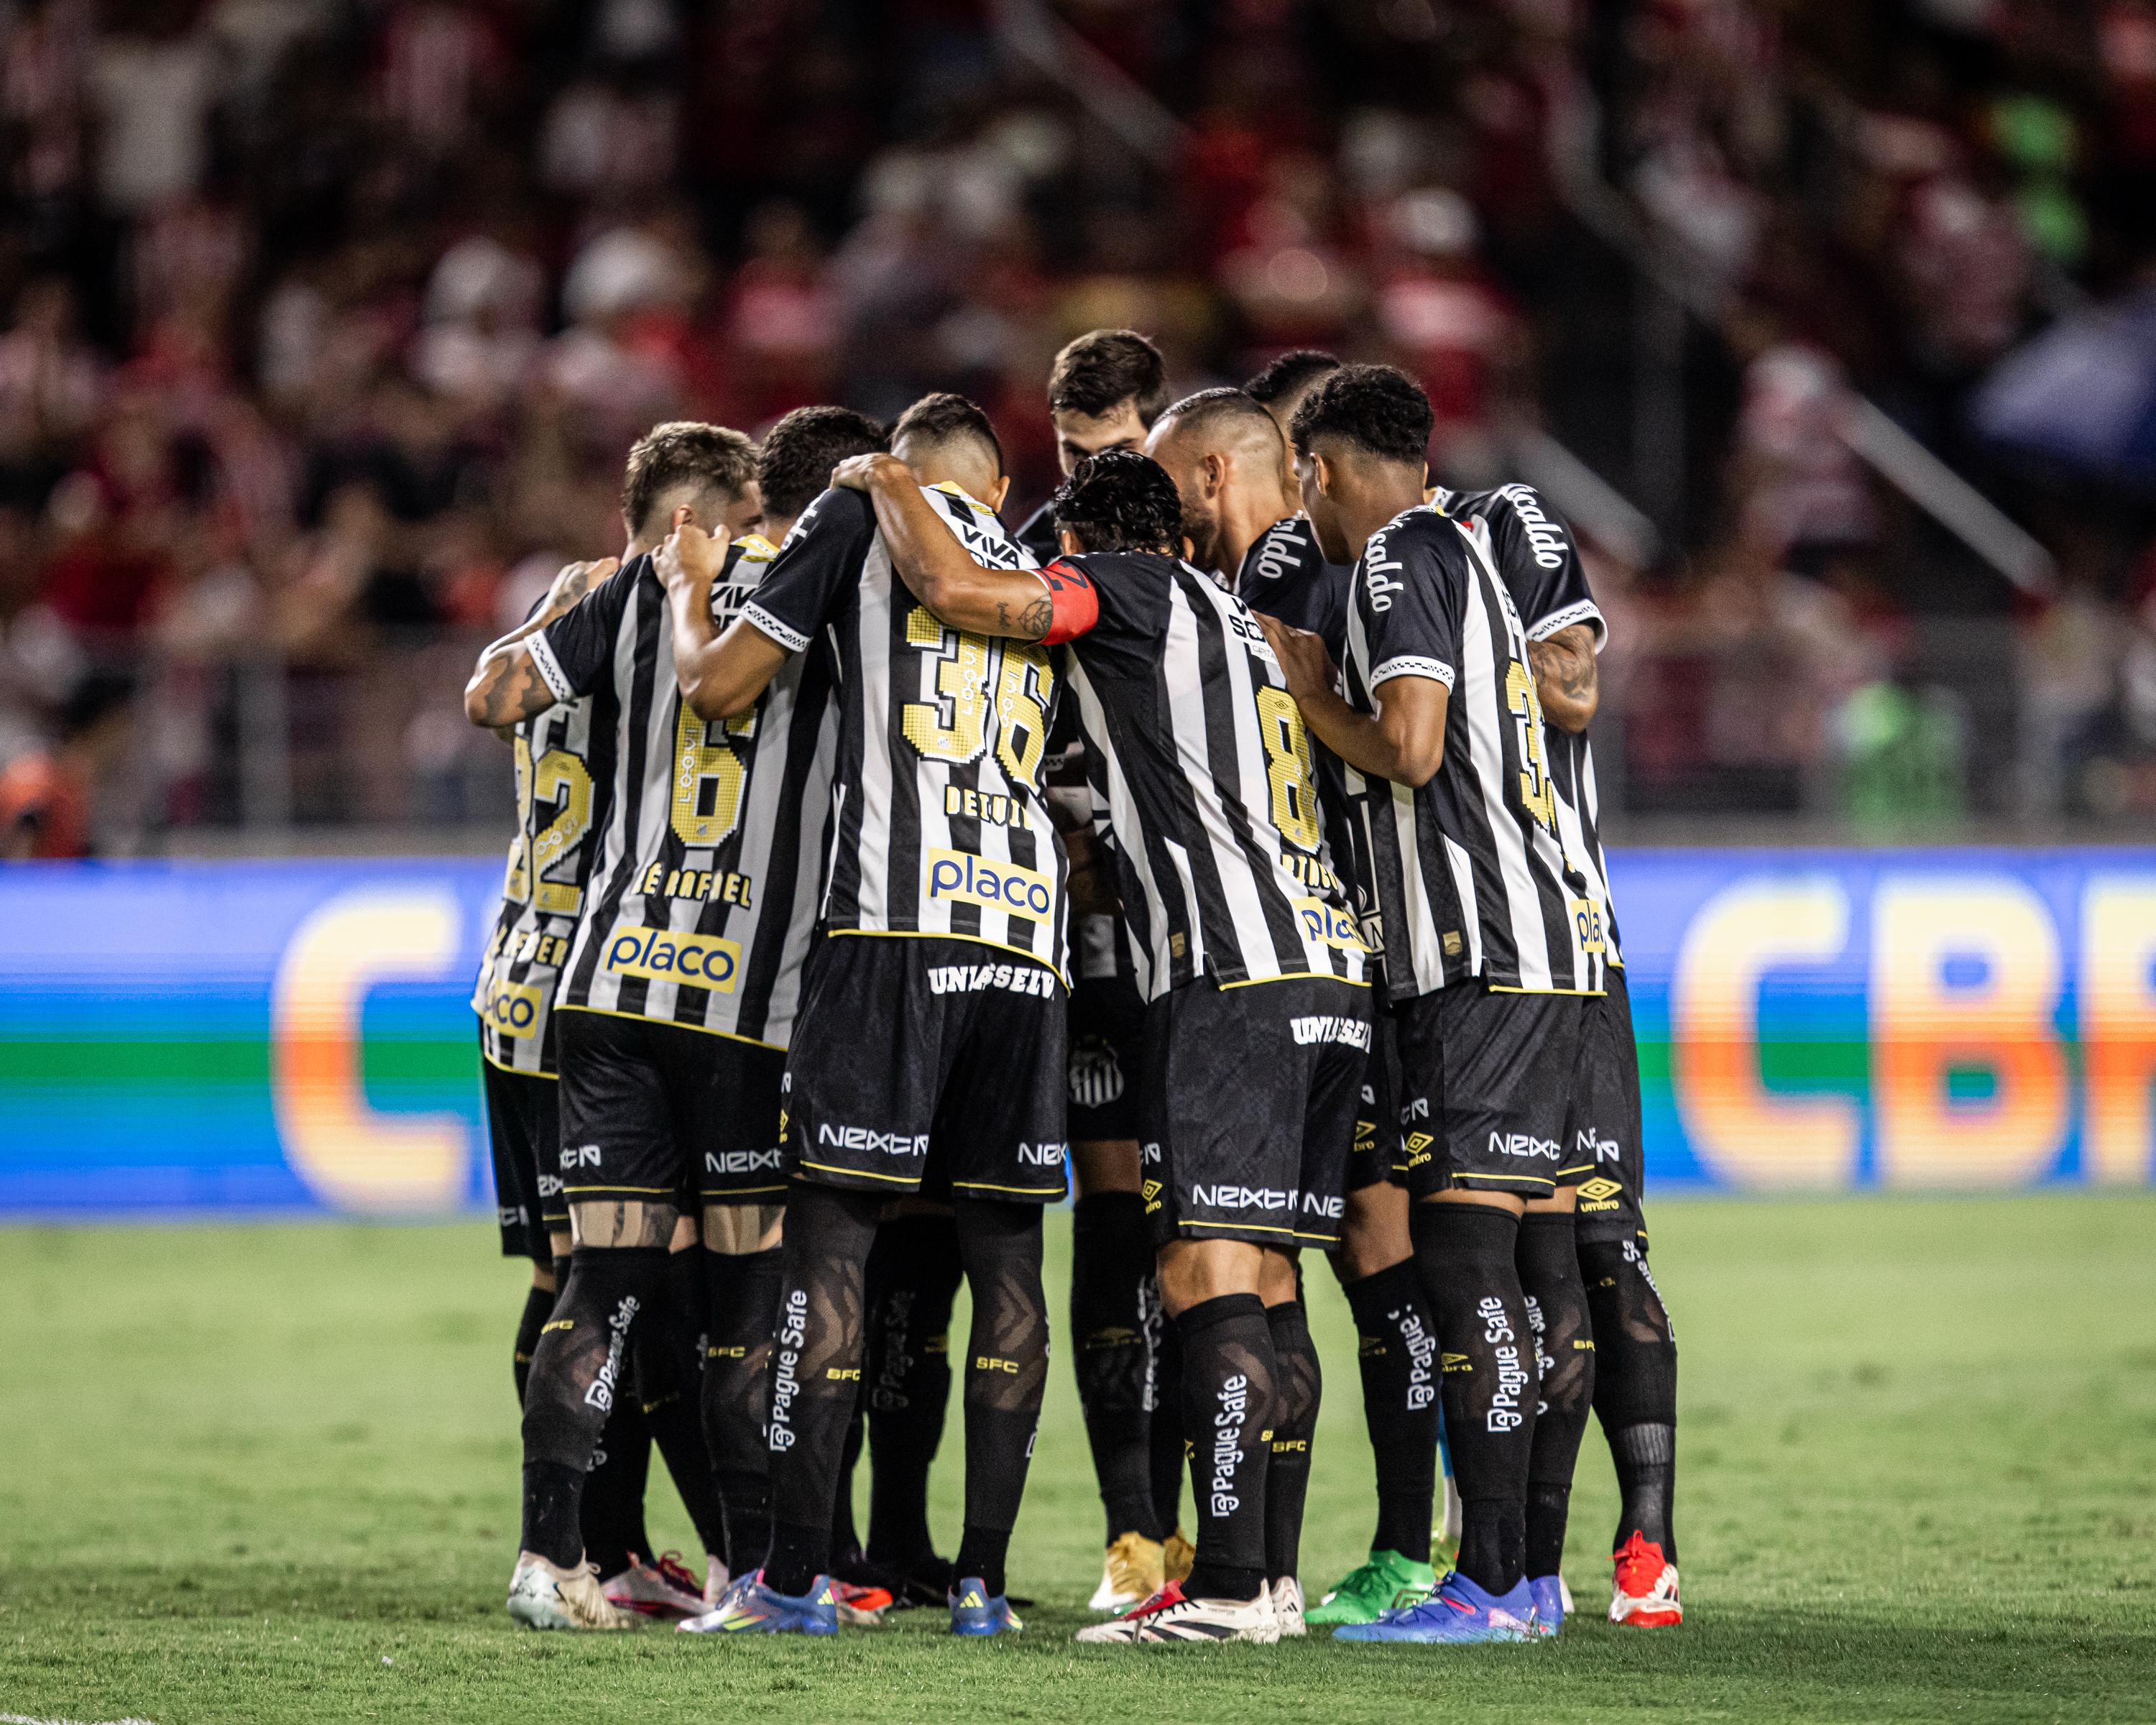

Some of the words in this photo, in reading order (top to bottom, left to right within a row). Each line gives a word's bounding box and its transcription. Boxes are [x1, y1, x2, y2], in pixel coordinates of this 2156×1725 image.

[962, 524, 1019, 569] VIVA
[903, 605, 1054, 788] 36
[670, 699, 760, 849] 6
[1256, 685, 1322, 855] 8
[931, 855, 1050, 915] placo
[607, 931, 735, 983] placo
[1580, 1199, 1620, 1213] umbro
[780, 1289, 807, 1348] Safe
[1478, 1296, 1515, 1344] Safe
[975, 1356, 1019, 1374] SFC
[1400, 1314, 1436, 1384] Pague
[1492, 1346, 1529, 1407] Pague
[773, 1351, 801, 1424] Pague
[1214, 1374, 1247, 1427] Safe
[1212, 1427, 1245, 1491] Pague
